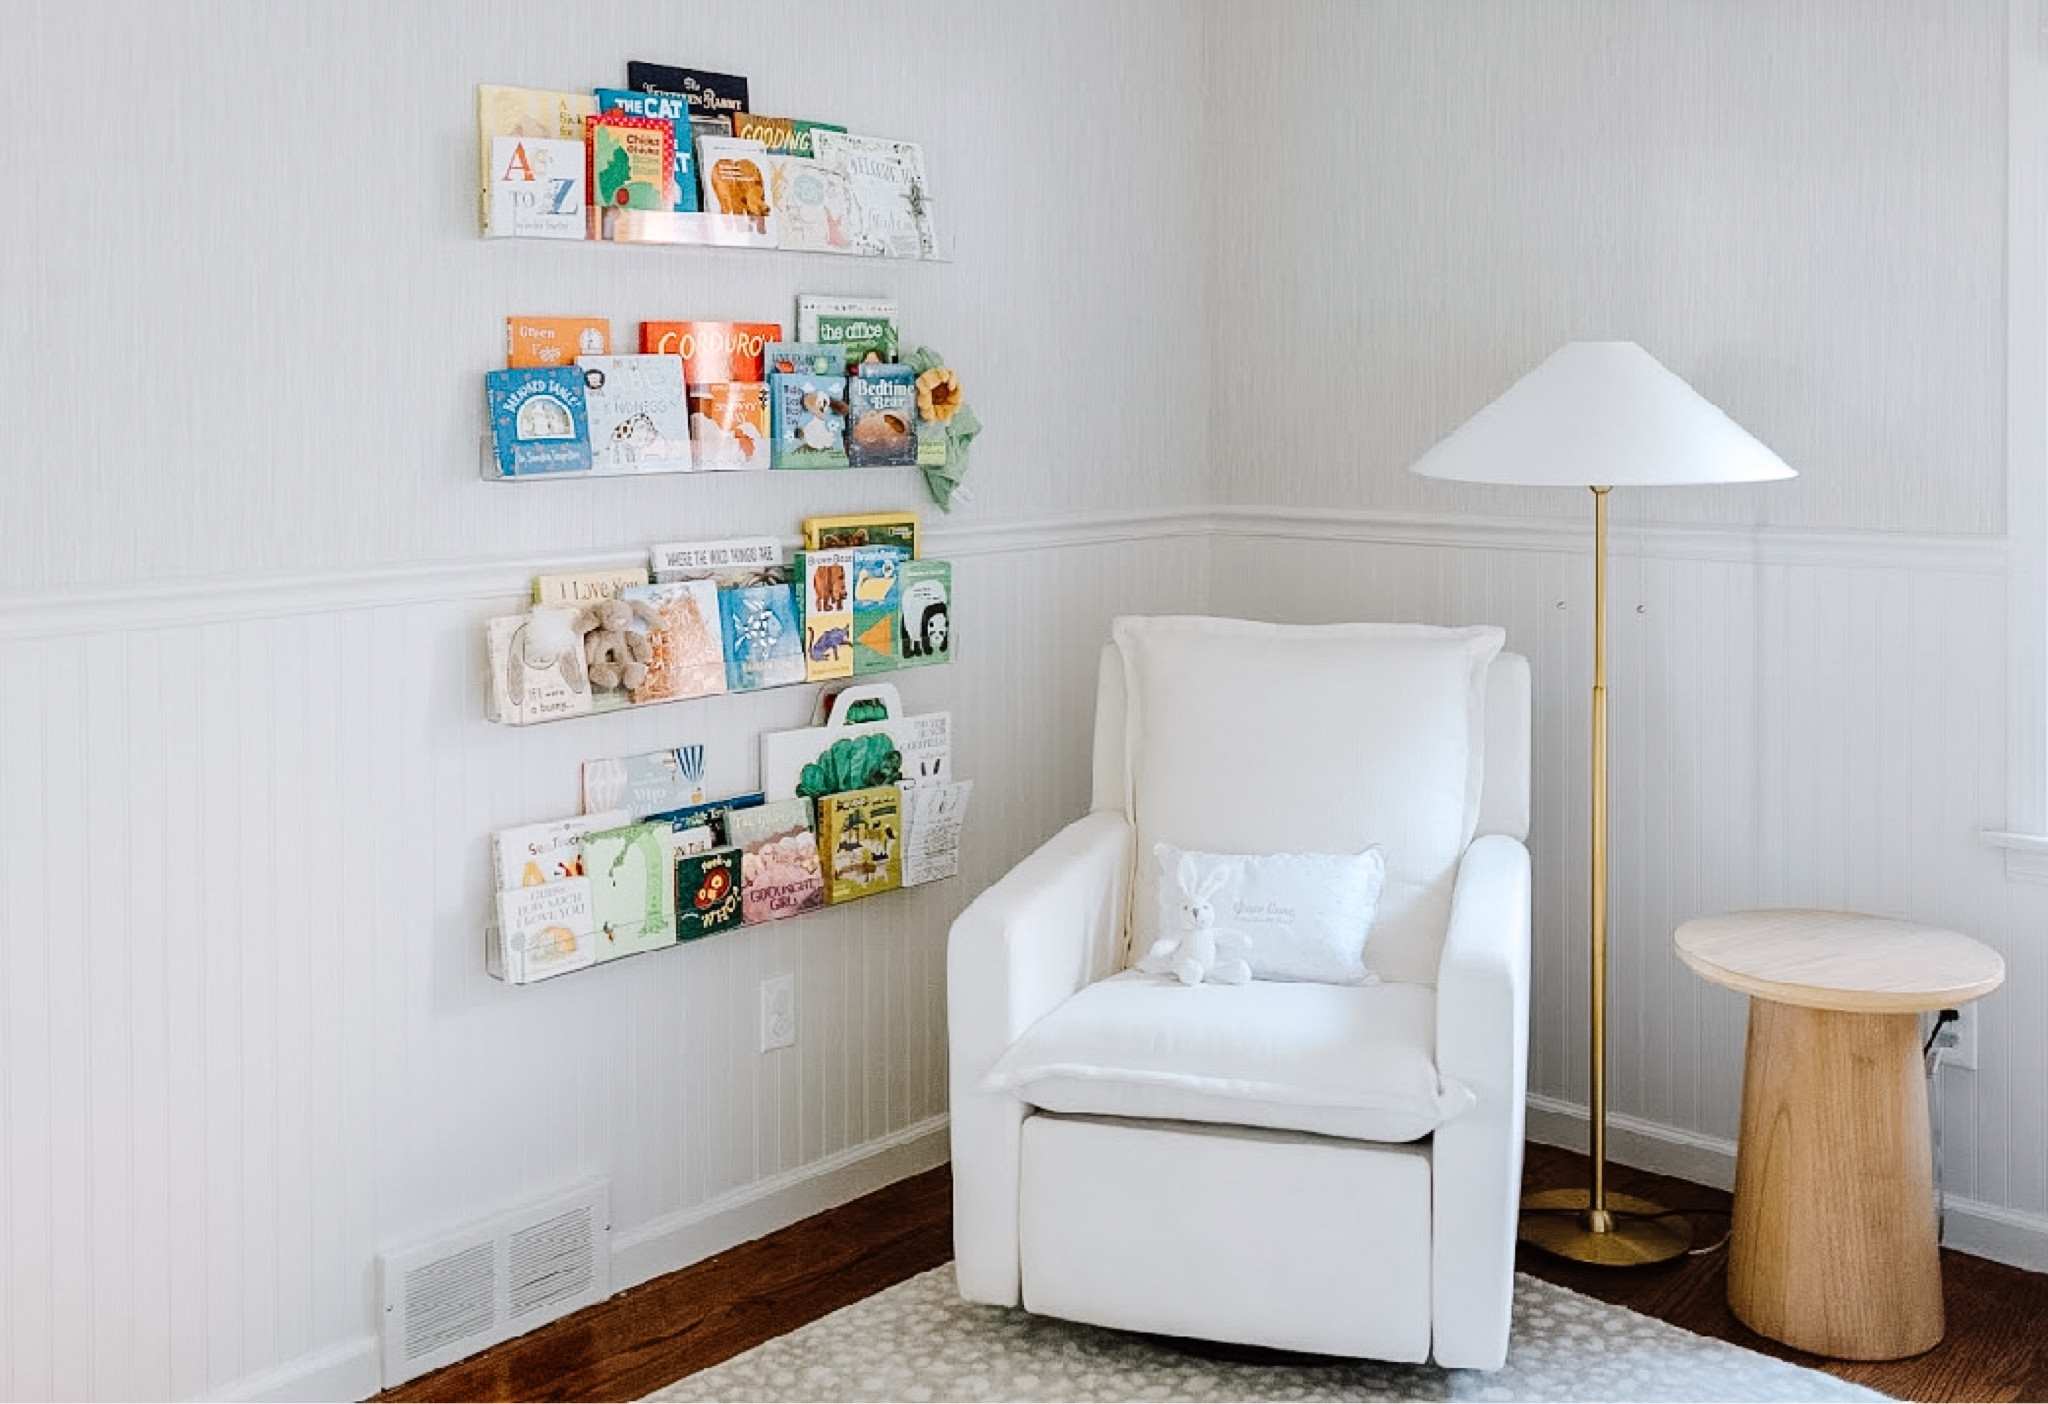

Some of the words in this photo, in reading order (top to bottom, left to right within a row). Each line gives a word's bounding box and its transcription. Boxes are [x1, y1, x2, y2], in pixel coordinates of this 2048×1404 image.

[615, 98, 643, 115] THE
[645, 98, 682, 118] CAT
[519, 326, 555, 340] Green
[821, 324, 843, 340] the
[845, 322, 883, 338] office
[532, 343, 561, 362] Eggs
[859, 379, 915, 396] Bedtime
[572, 580, 609, 600] Love
